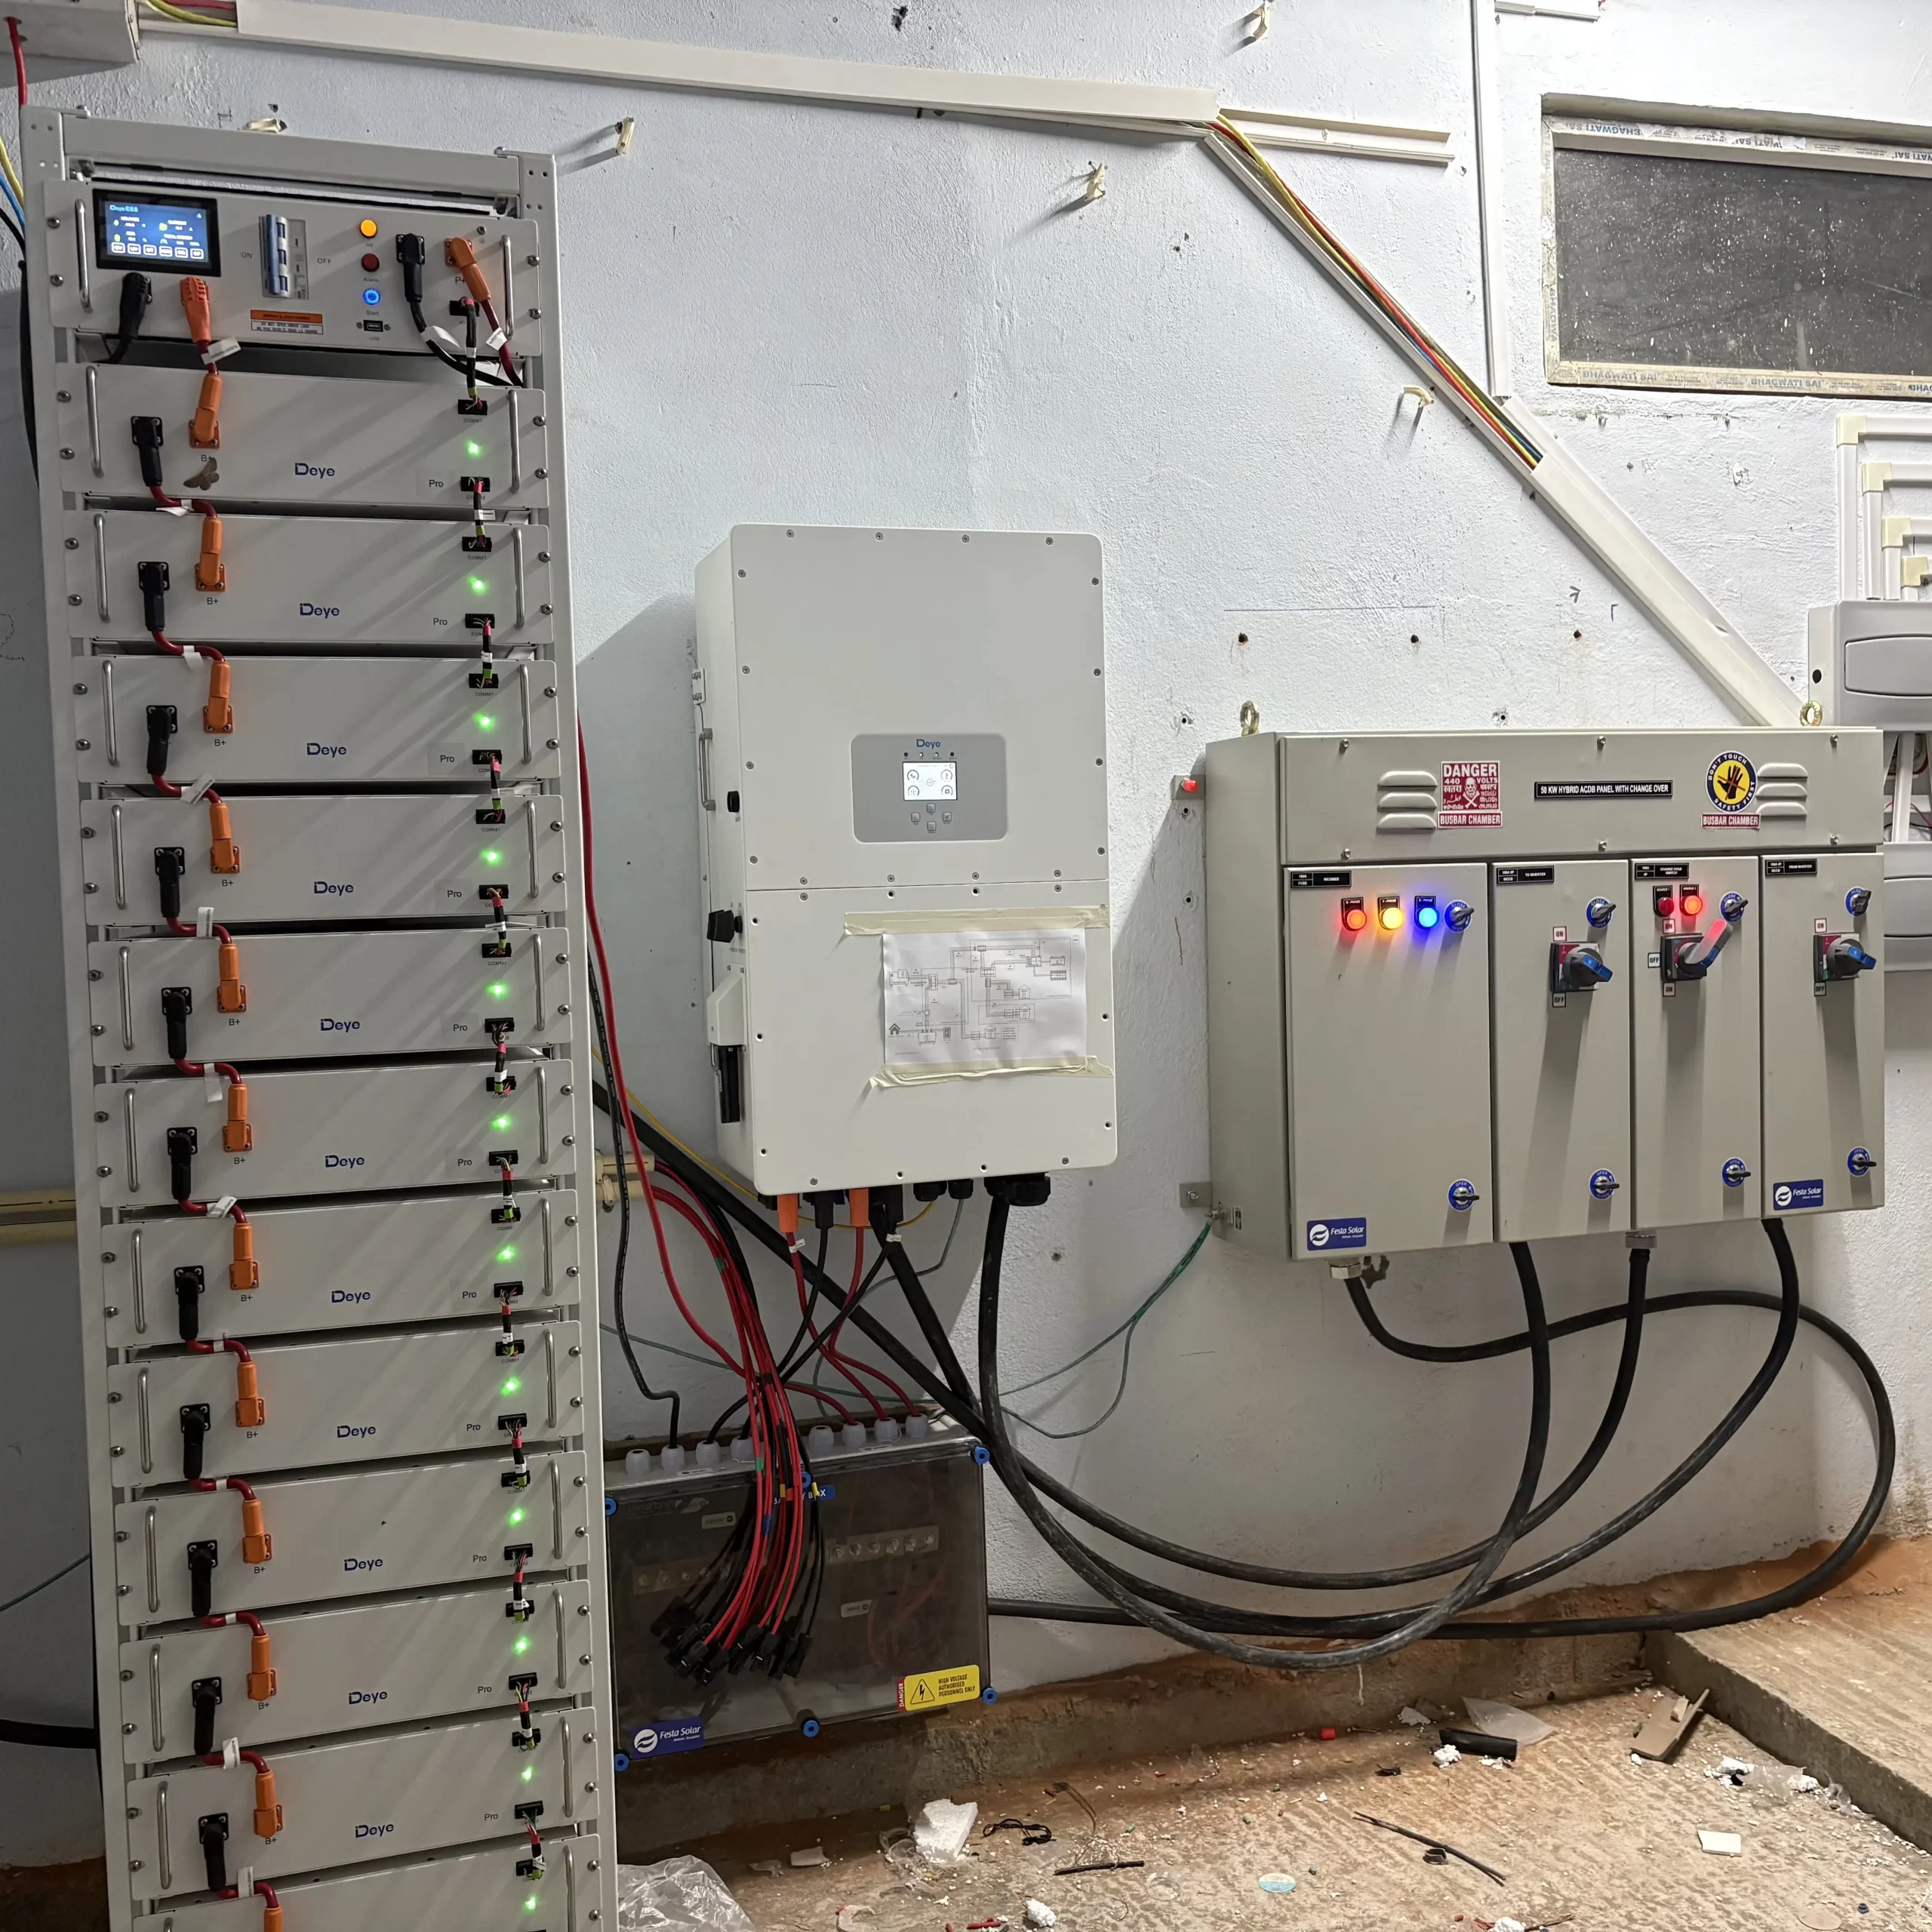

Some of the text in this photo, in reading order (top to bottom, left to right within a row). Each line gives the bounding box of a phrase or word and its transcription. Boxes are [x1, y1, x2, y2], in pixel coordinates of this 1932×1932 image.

[295, 463, 335, 479] Deye
[429, 479, 444, 488] Pro
[300, 603, 340, 620] Deye
[433, 617, 448, 626] Pro
[916, 738, 941, 749] Deye
[307, 743, 347, 758] Deye
[440, 755, 455, 763] Pro
[1443, 764, 1497, 777] DANGER
[1708, 754, 1747, 780] DON'T TOUCH
[1548, 786, 1558, 794] KW
[1558, 786, 1579, 794] HYBRID
[1596, 785, 1614, 793] PANEL
[1615, 785, 1629, 793] WITH
[1654, 784, 1669, 792] OVER
[1714, 781, 1755, 811] SAFETY FIRST
[1440, 814, 1500, 825] BUSBAR CHAMBER
[1703, 816, 1758, 826] BUSBAR CHAMBER
[314, 881, 354, 897] Deye
[447, 890, 462, 898] Pro
[321, 1019, 361, 1033] Deye
[453, 1023, 468, 1032] Pro
[325, 1155, 365, 1169] Deye
[457, 1158, 472, 1167] Pro
[1331, 1227, 1347, 1235] Festa
[331, 1291, 371, 1304] Deye
[463, 1291, 477, 1299] Pro
[337, 1426, 377, 1438] Deye
[466, 1423, 481, 1432] Pro
[808, 1489, 826, 1499] BX
[254, 1566, 266, 1574] B+
[344, 1558, 383, 1572] Deye
[949, 1674, 968, 1683] VOLTAGE
[478, 1686, 492, 1694] Pro
[938, 1682, 964, 1690] AUTHORISED
[939, 1687, 964, 1697] PERSONNEL
[349, 1692, 388, 1705] Deye
[660, 1730, 679, 1740] Festa
[681, 1726, 701, 1736] Solar
[484, 1813, 499, 1822] Pro
[355, 1823, 395, 1838] Deye
